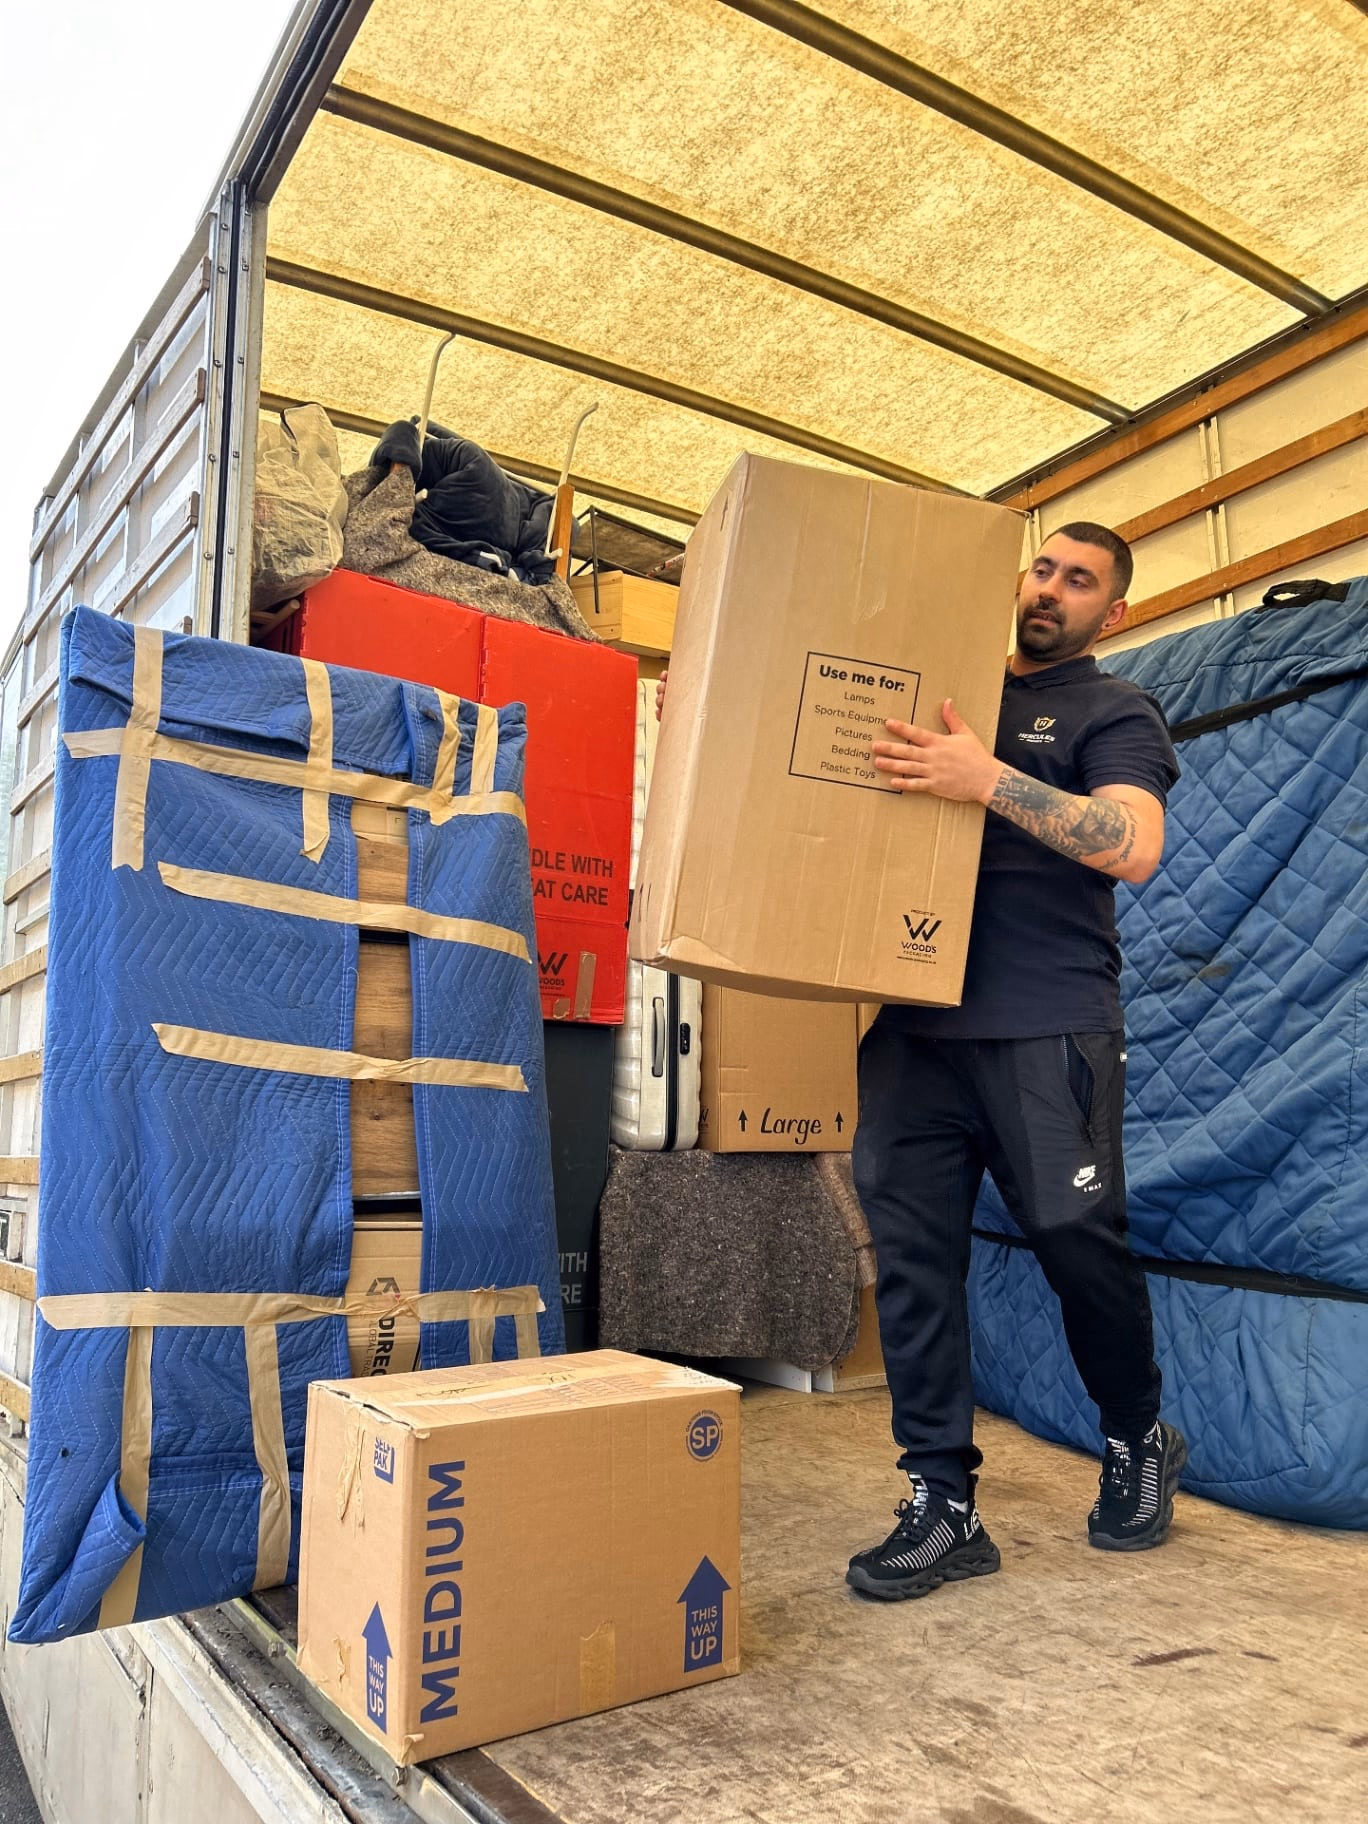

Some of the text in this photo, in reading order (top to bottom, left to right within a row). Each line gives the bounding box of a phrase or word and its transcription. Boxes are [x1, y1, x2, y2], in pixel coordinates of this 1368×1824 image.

[819, 664, 905, 692] Use me for:
[844, 691, 876, 705] Lamps
[814, 704, 846, 719] Sports
[835, 726, 873, 742] Pictures
[831, 744, 871, 761] Bedding
[820, 761, 876, 780] Plastic Toys
[529, 847, 614, 878] DLE WITH
[530, 878, 609, 906] AT CARE
[760, 1107, 822, 1145] Large
[1078, 1164, 1096, 1179] NIKE
[558, 1251, 588, 1273] ITH
[691, 1425, 719, 1450] SP
[373, 1450, 388, 1470] PAK
[420, 1460, 466, 1724] MEDIUM
[691, 1605, 718, 1623] THIS
[691, 1620, 718, 1638] WAY
[691, 1635, 718, 1660] UP
[368, 1655, 384, 1679] THIS
[368, 1671, 384, 1695] WAY
[369, 1688, 384, 1718] UP
